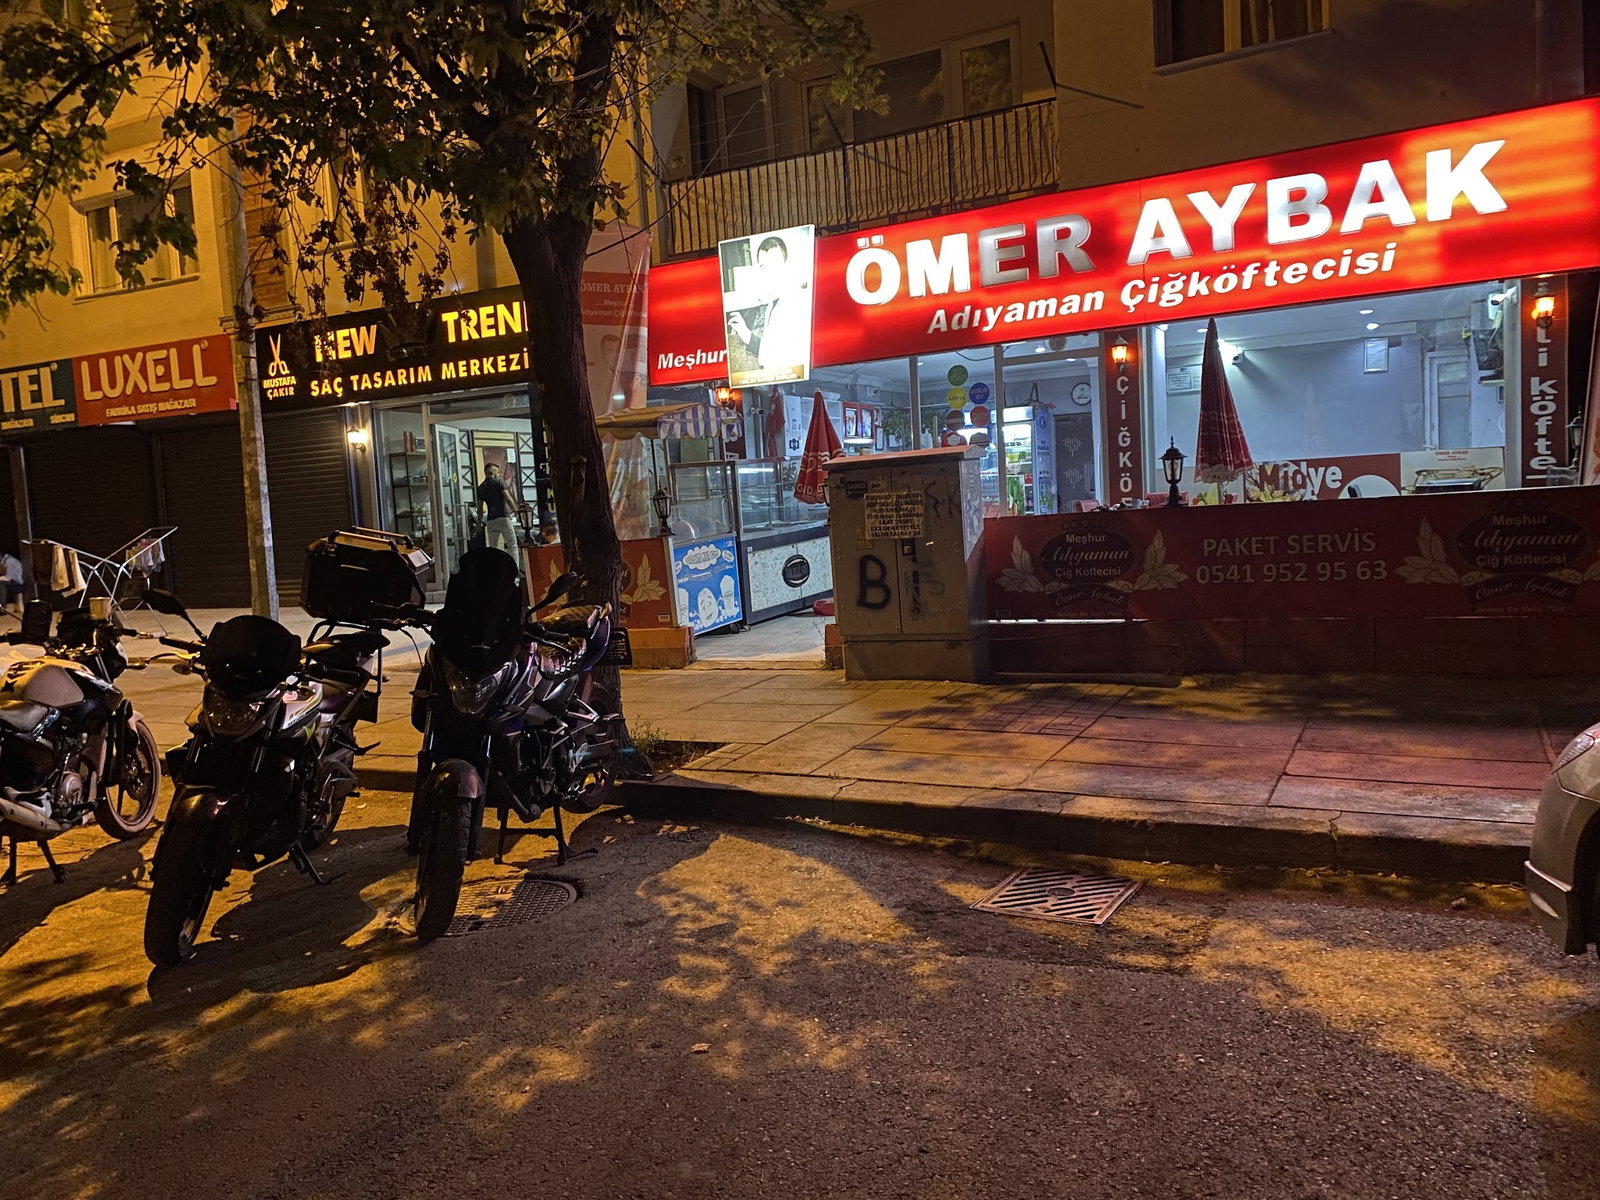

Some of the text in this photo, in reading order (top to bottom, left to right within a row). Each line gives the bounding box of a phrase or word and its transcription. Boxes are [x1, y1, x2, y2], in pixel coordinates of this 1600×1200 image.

[845, 139, 1508, 305] ÖMER AYBAK
[928, 243, 1397, 334] Adıyaman Çiğköftecisi
[314, 300, 529, 362] NEW TREN
[81, 344, 218, 401] LUXELL
[310, 347, 530, 398] SAÇ TASARIM MERKEZİ
[658, 349, 727, 370] Meşhur
[263, 375, 296, 389] MUSTAFA
[266, 387, 295, 400] ÇAKIR
[1065, 532, 1106, 545] Meşhur
[1203, 527, 1377, 557] PAKET SERVİS
[857, 555, 891, 610] B
[1076, 565, 1121, 577] Köftecisi
[1196, 559, 1388, 584] 0541 952 95 63
